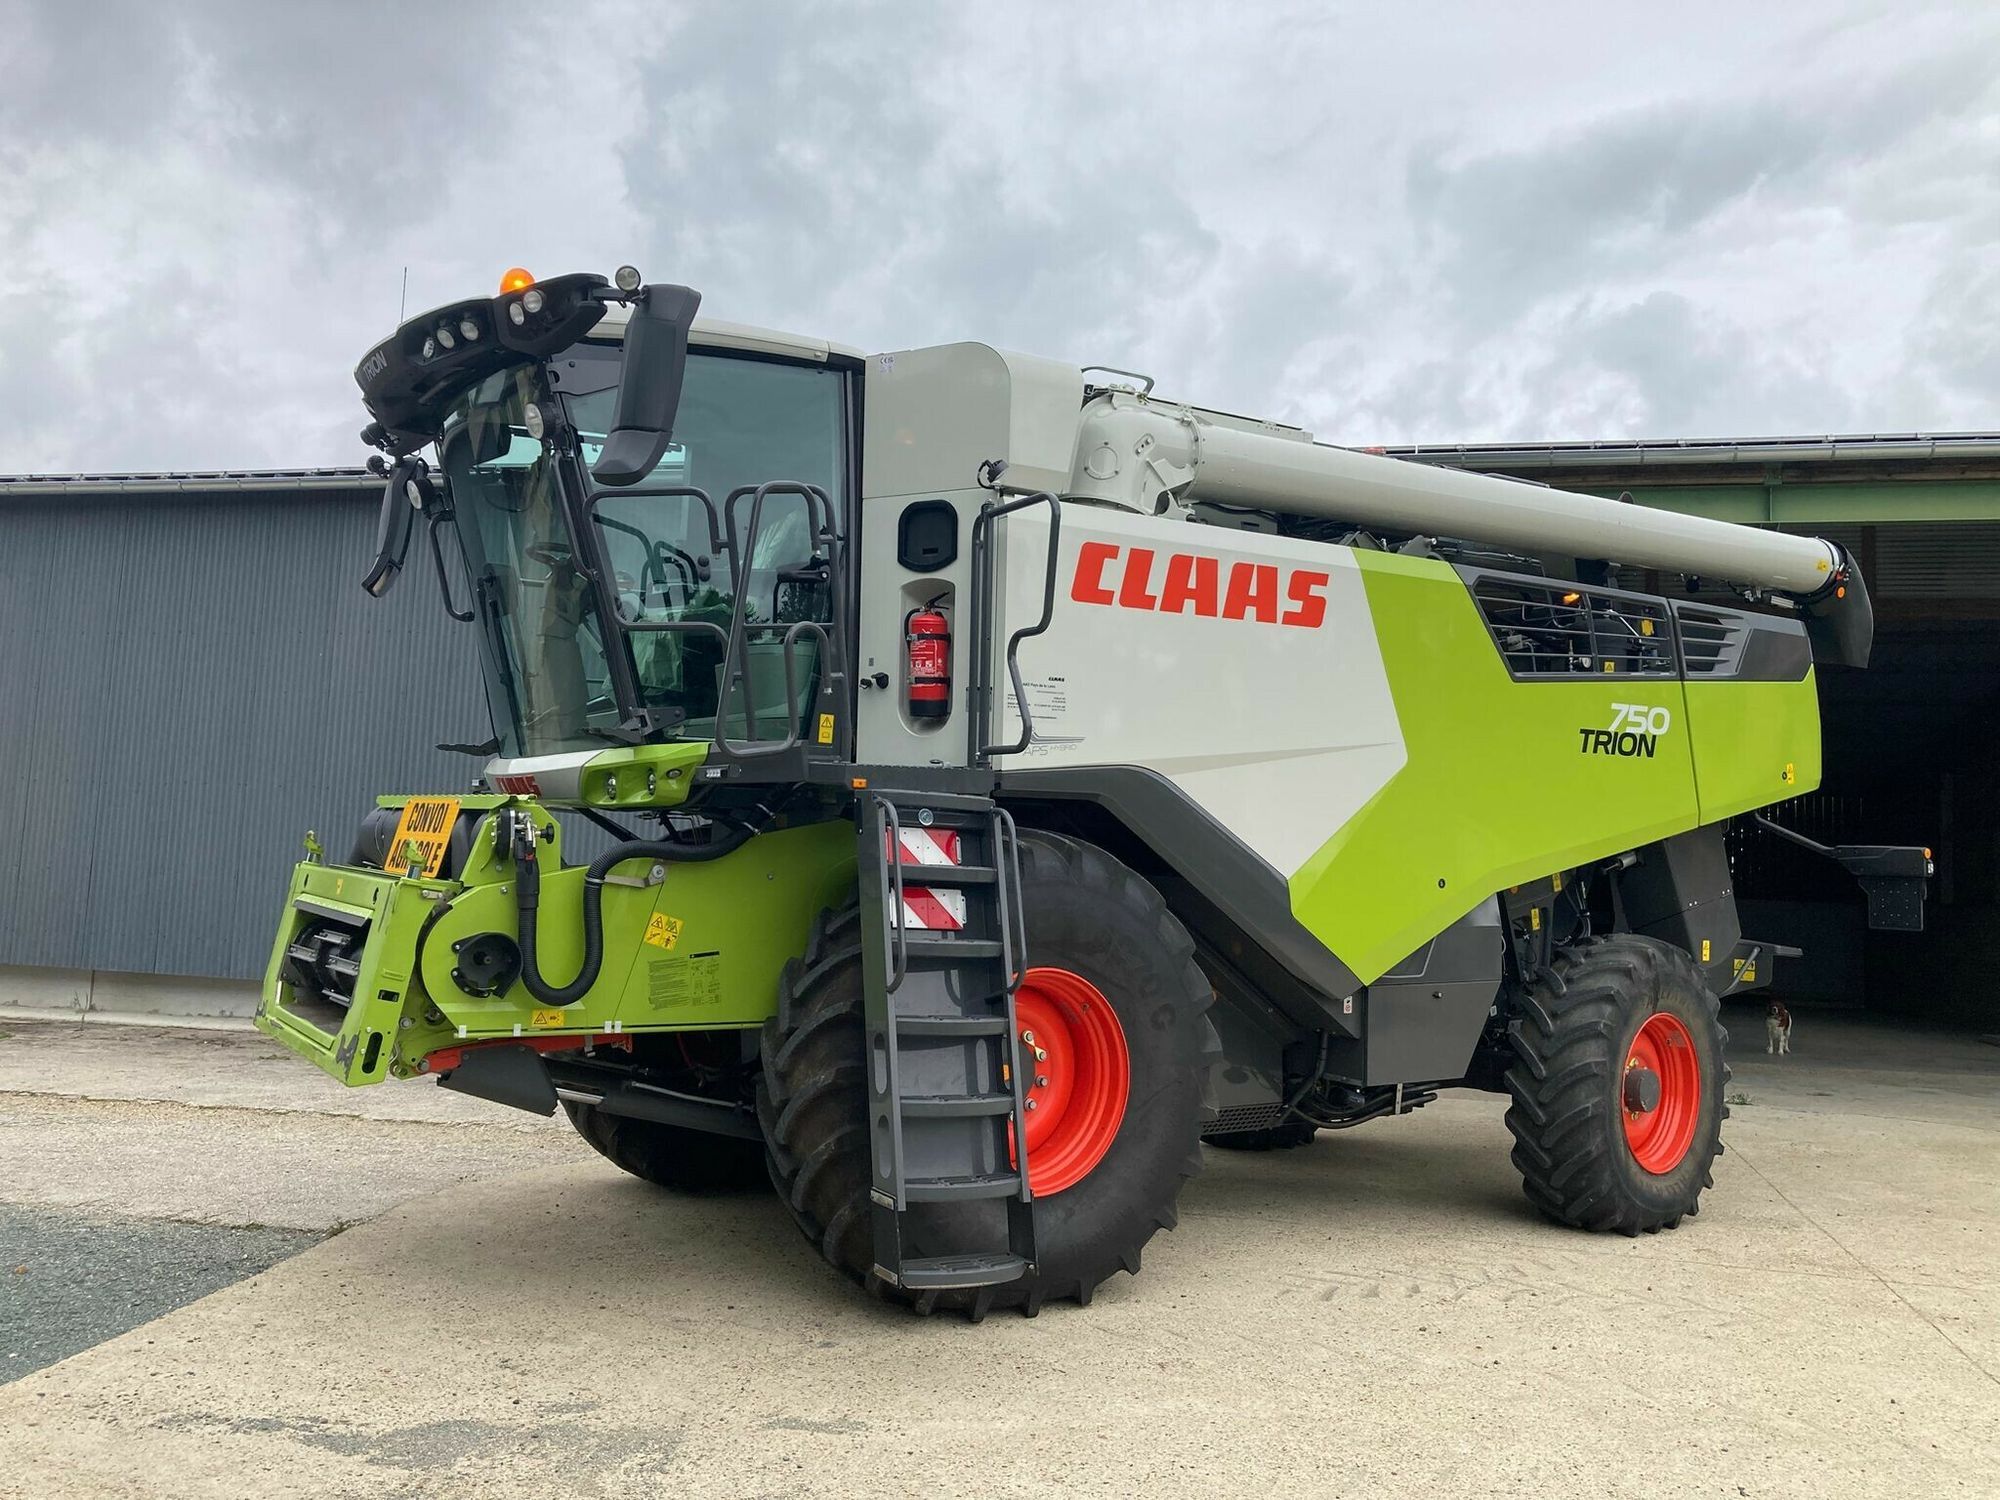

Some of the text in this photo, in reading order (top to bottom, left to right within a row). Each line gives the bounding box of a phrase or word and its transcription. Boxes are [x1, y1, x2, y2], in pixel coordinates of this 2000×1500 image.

[1071, 541, 1329, 628] CLAAS
[1608, 703, 1670, 735] 750
[1580, 728, 1657, 758] TRION
[406, 802, 450, 834] CONVOI
